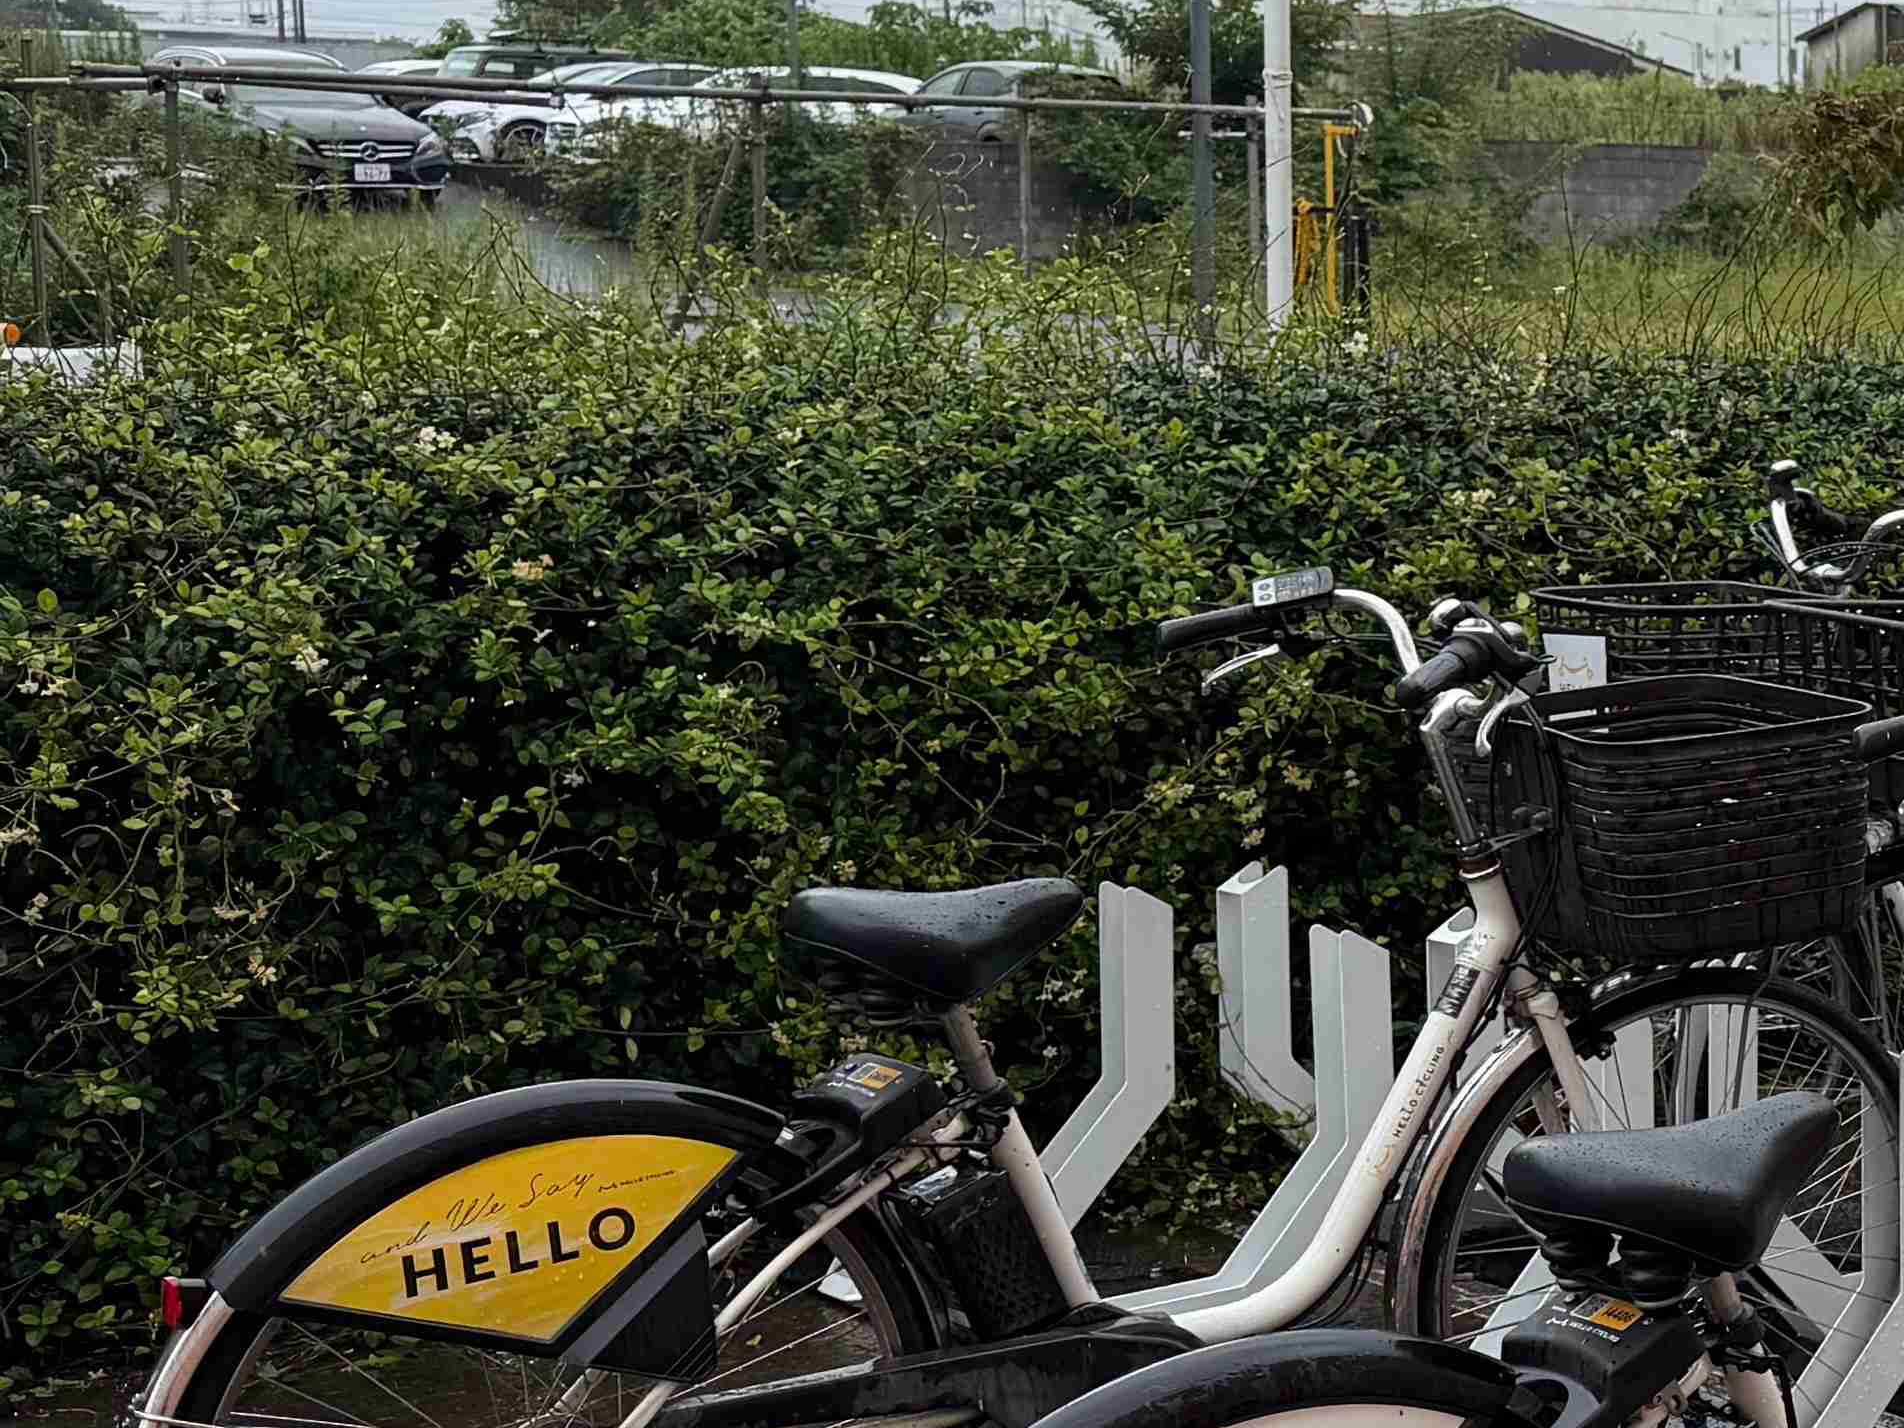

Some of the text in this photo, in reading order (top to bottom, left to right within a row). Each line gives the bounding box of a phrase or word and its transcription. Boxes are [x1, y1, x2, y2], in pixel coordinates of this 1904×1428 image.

[1392, 1046, 1445, 1140] HELLO CYCLING
[446, 1192, 507, 1232] We
[518, 1172, 595, 1209] Say
[401, 1206, 636, 1299] HELLO
